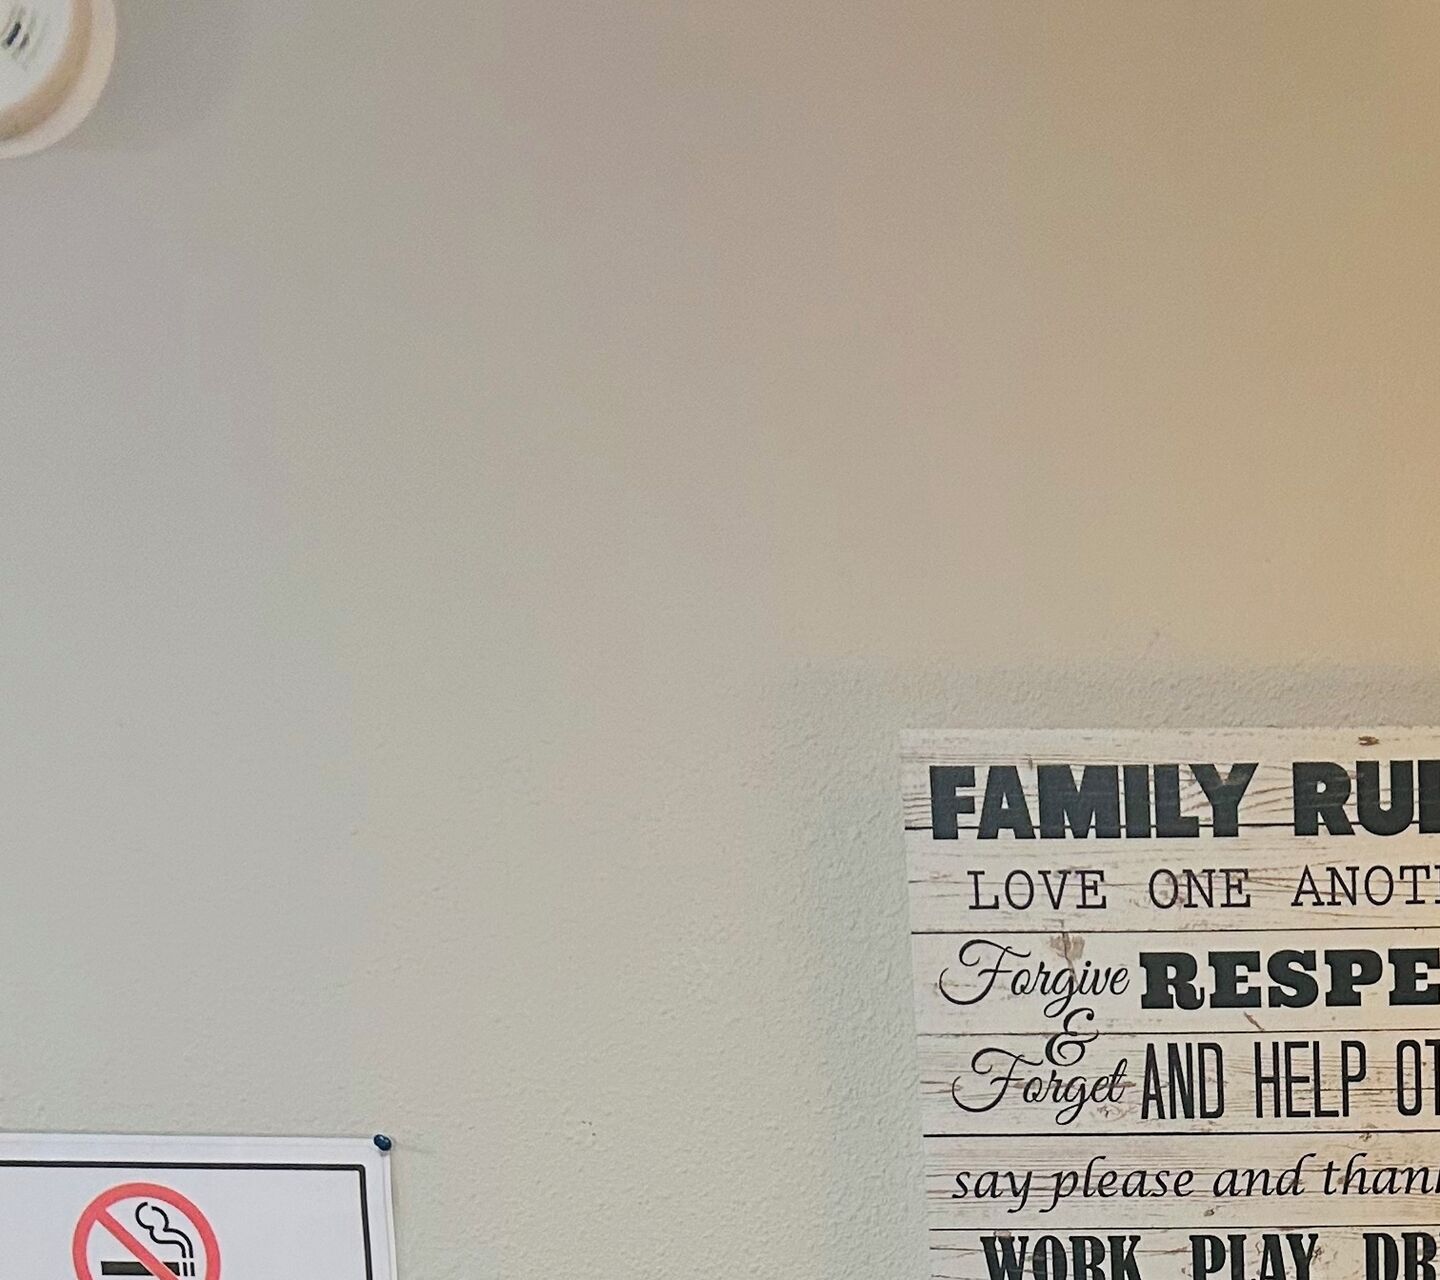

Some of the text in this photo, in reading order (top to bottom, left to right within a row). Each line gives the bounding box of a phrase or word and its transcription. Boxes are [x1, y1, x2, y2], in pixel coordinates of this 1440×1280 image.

[929, 762, 1259, 841] FAMILY
[967, 869, 1107, 911] LOVE
[1149, 868, 1252, 908] ONE
[939, 939, 1130, 1016] Forgive
[1045, 1008, 1100, 1065] &
[951, 1047, 1128, 1124] Forget
[1141, 1042, 1224, 1120] AND
[1255, 1040, 1367, 1118] HELP
[951, 1166, 1034, 1212] say
[1039, 1155, 1195, 1212] please
[1213, 1153, 1317, 1198] and
